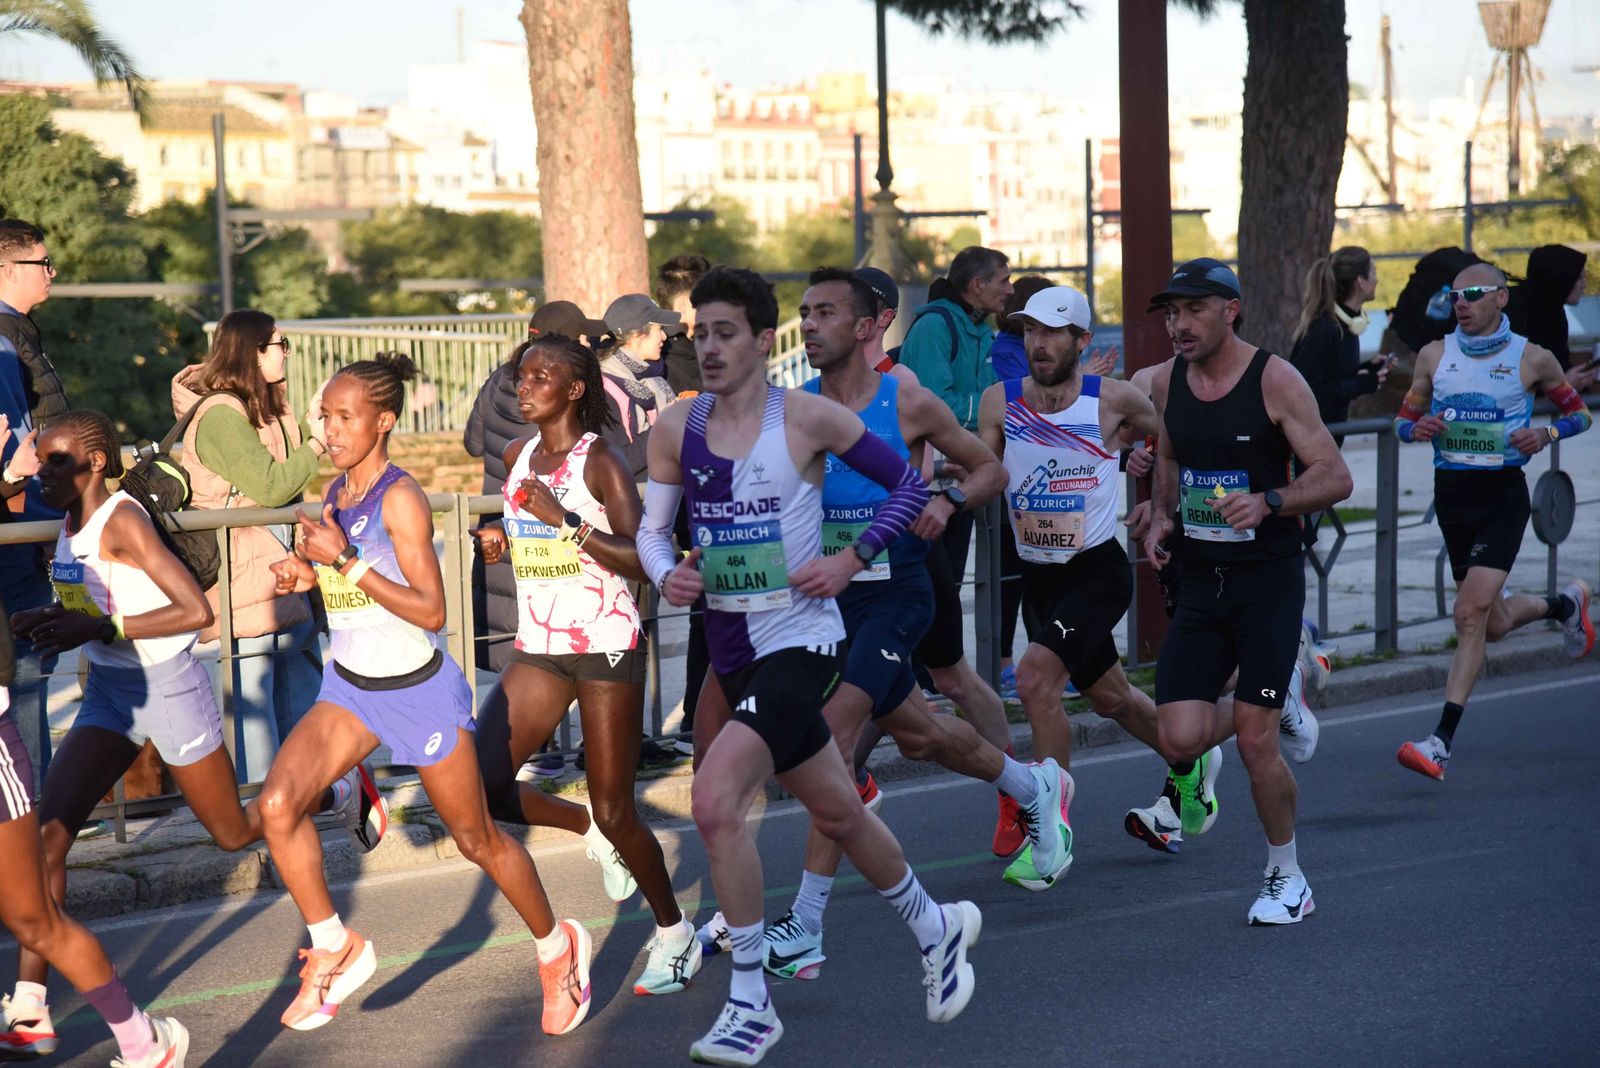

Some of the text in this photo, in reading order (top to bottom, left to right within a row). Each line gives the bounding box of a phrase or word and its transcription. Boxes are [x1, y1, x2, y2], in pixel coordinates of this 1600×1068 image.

[1460, 410, 1497, 420] ZURICH
[1446, 439, 1495, 452] BURGOS
[1196, 475, 1239, 485] ZURICH
[1033, 499, 1075, 508] ZURICH
[828, 507, 874, 520] ZURICH
[1187, 508, 1228, 524] REMR
[522, 524, 557, 536] ZURICH
[1037, 519, 1054, 529] 264
[717, 526, 770, 542] ZURICH
[836, 531, 853, 542] 456
[1023, 528, 1076, 548] ÁLVAREZ
[524, 547, 549, 557] F-124
[726, 555, 746, 567] 464
[715, 571, 768, 592] ALLAN
[1261, 688, 1276, 699] CR
